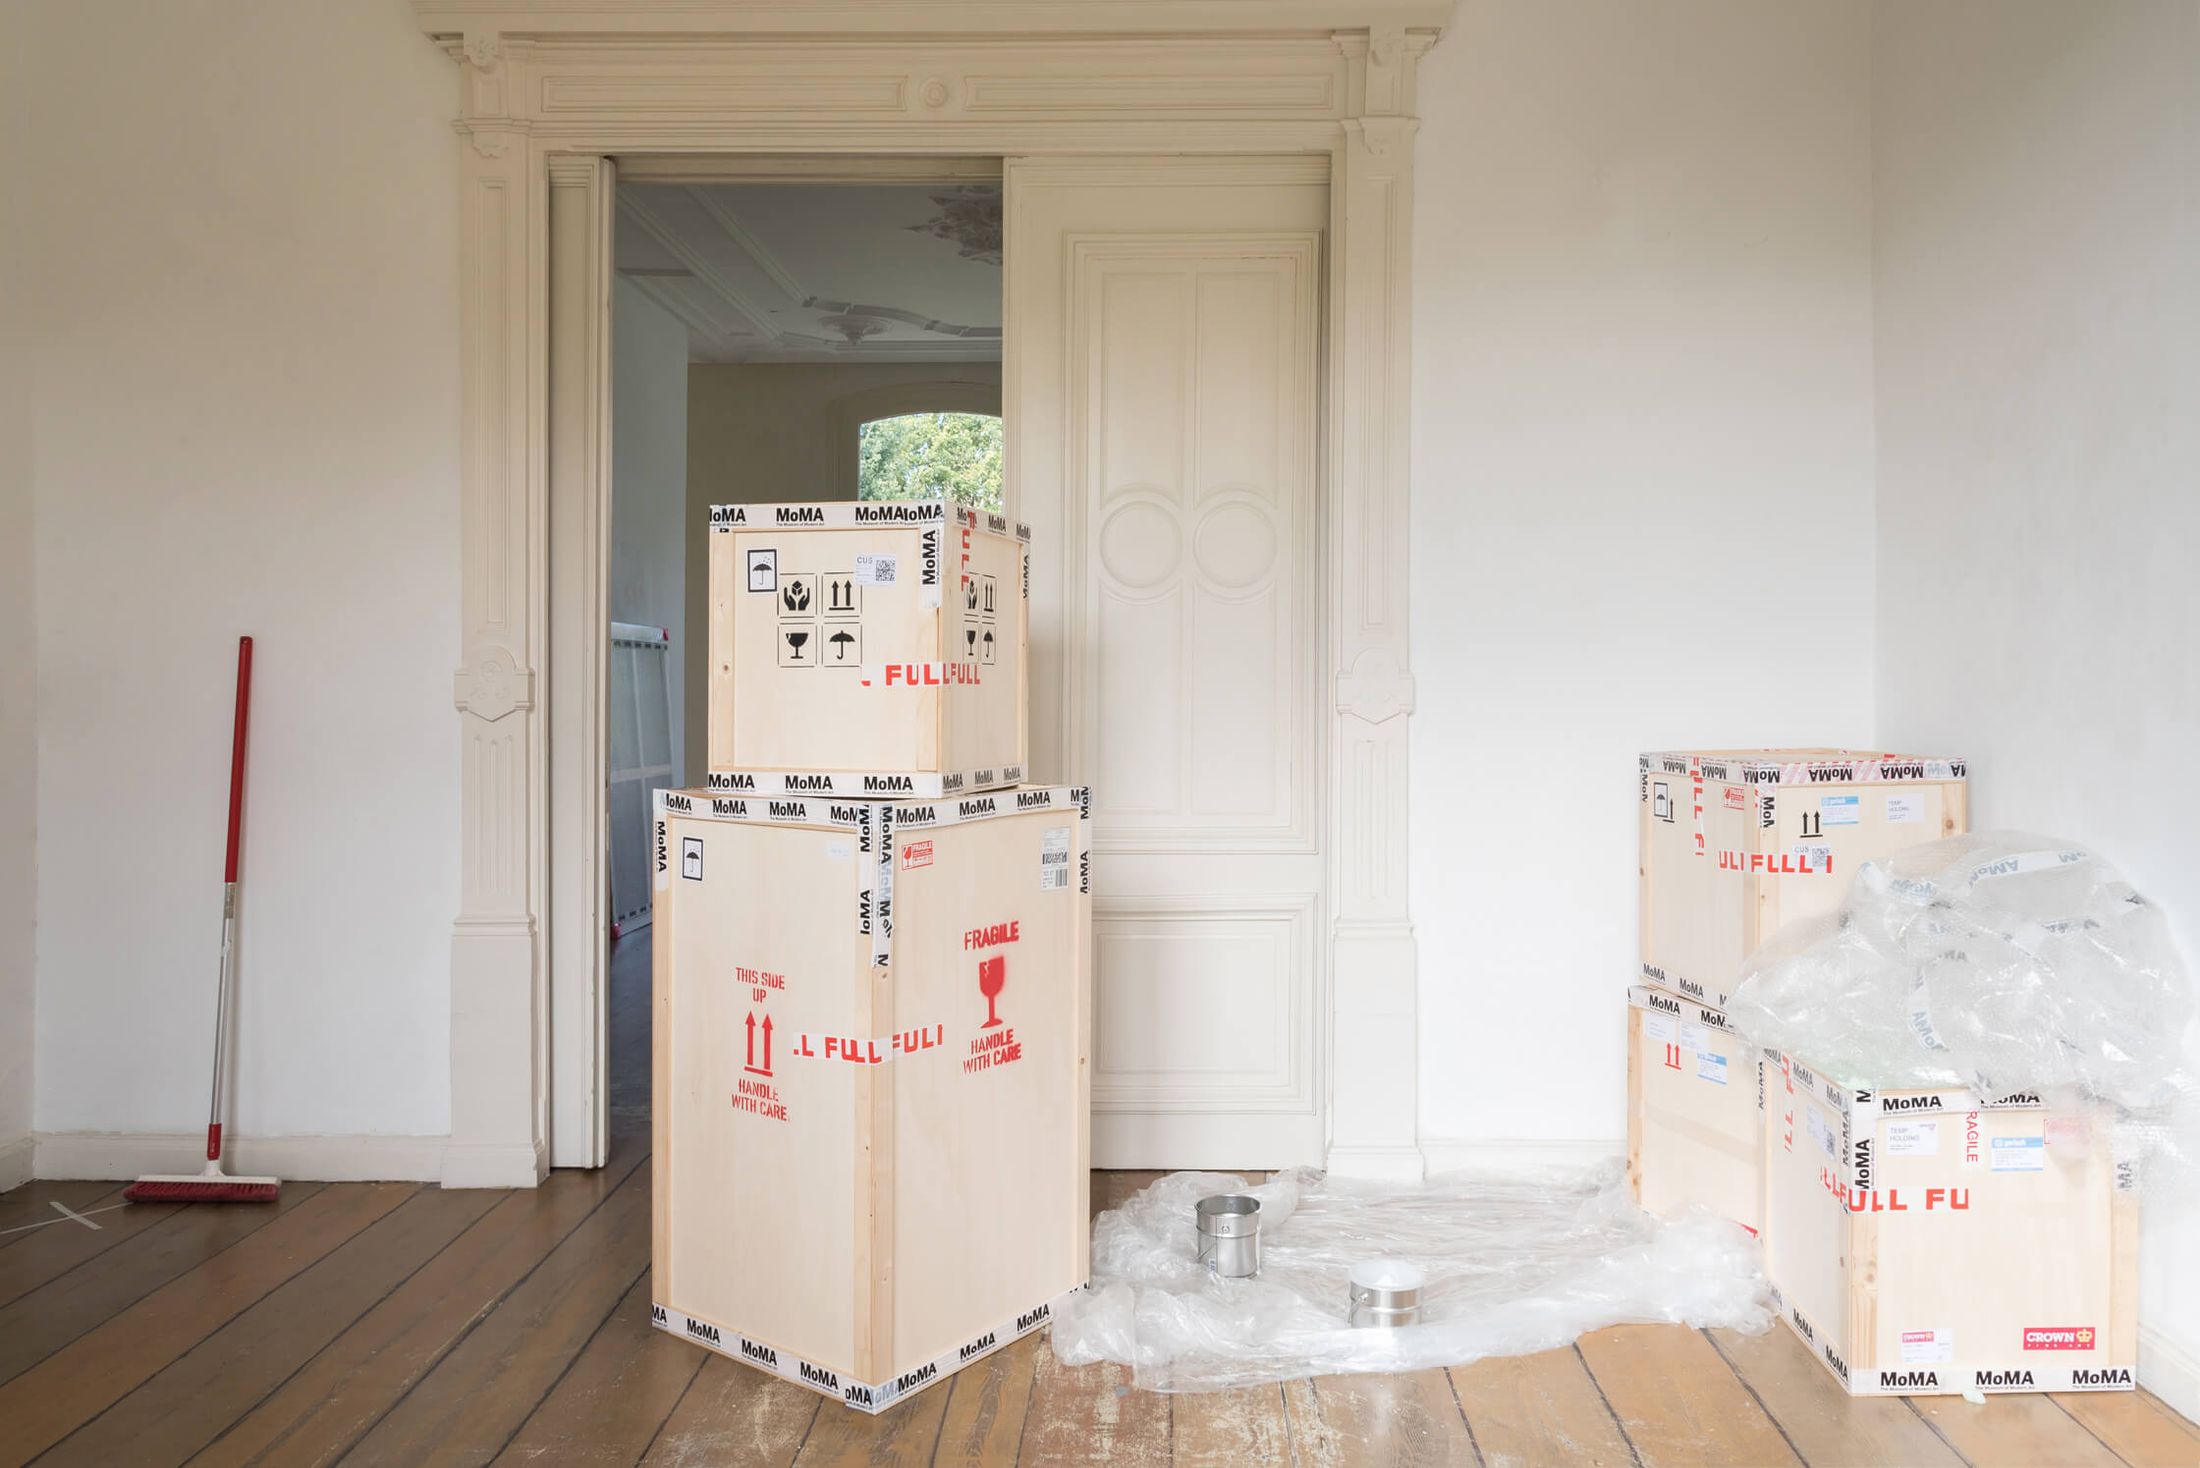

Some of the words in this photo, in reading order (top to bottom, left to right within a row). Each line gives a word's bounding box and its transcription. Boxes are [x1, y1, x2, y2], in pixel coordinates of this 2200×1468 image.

[776, 508, 824, 521] MoMA
[855, 506, 904, 521] MoMA
[988, 514, 1007, 532] MoMA
[922, 530, 936, 585] MoMA
[708, 774, 755, 788] MoMA
[785, 776, 833, 789] MoMA
[864, 776, 914, 790] MoMA
[943, 773, 964, 790] MoMA
[975, 770, 993, 784] MoMA
[1004, 767, 1021, 781] MoMA
[1701, 765, 1727, 780] MoMA
[1809, 769, 1853, 782] MoMA
[1880, 766, 1924, 779] MoMA
[713, 799, 747, 815] MoMA
[769, 801, 807, 817] MoMA
[831, 806, 858, 822] MoM
[896, 806, 936, 823] MoMA
[959, 798, 996, 816] MoMA
[1017, 791, 1051, 807] MoMA
[859, 804, 871, 852] MoM
[882, 806, 893, 864] MoMA
[658, 821, 667, 872] MoMA
[964, 920, 1019, 951] FRAGILE
[735, 966, 759, 985] THIS
[761, 971, 785, 990] SIDE
[1643, 963, 1666, 982] MoMA
[1679, 977, 1705, 999] MoMA
[752, 987, 767, 1003] UP
[1650, 995, 1681, 1015] MoMA
[1701, 1010, 1730, 1029] MoM
[825, 1036, 882, 1064] FULL
[970, 1028, 1014, 1055] HANDLE
[963, 1052, 991, 1074] WITH
[993, 1043, 1022, 1066] CARE
[1793, 1061, 1814, 1088] MoMA
[731, 1093, 757, 1113] WITH
[738, 1078, 779, 1102] HANDLE
[1882, 1096, 1942, 1111] MoMA
[897, 1361, 937, 1391] MoMA
[959, 1332, 996, 1360] MoMA
[1016, 1303, 1050, 1331] MoMA
[1793, 1308, 1814, 1341] MoMA
[1825, 1346, 1849, 1381] MoMA
[2026, 1332, 2075, 1342] CROWN
[687, 1317, 721, 1344] MoMA
[741, 1338, 778, 1366] MoMA
[800, 1361, 839, 1390] MoMA
[845, 1385, 873, 1406] oMA
[1881, 1371, 1939, 1386] MoMA
[1976, 1370, 2035, 1385] MoMA
[2072, 1369, 2132, 1384] MoMA
